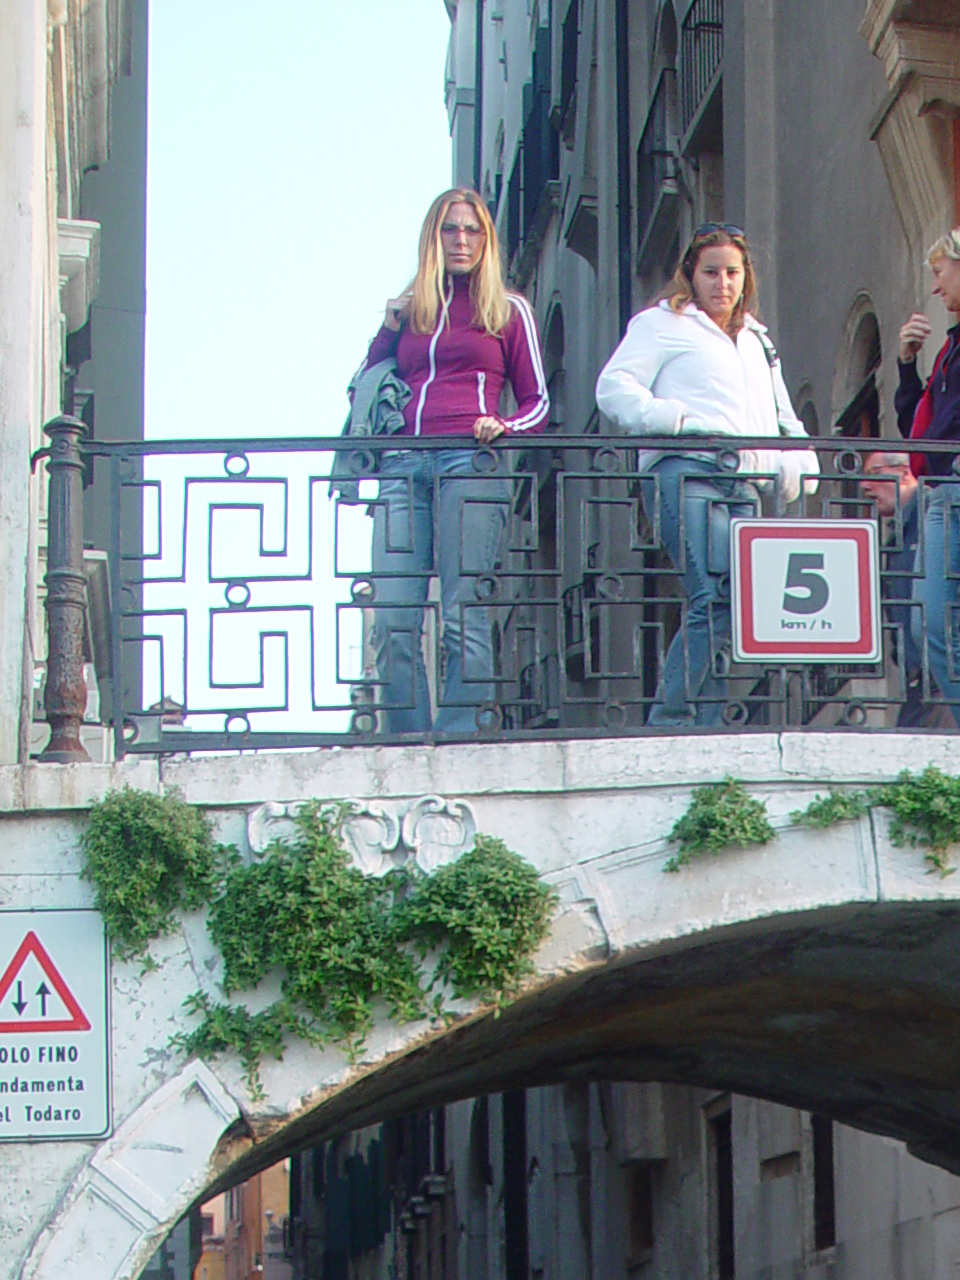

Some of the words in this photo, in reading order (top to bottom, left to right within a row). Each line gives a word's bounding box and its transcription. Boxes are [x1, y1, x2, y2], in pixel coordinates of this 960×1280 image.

[782, 553, 829, 615] 5
[38, 1045, 78, 1063] FINO
[0, 1075, 85, 1094] ndamenta
[25, 1104, 81, 1122] Todaro
